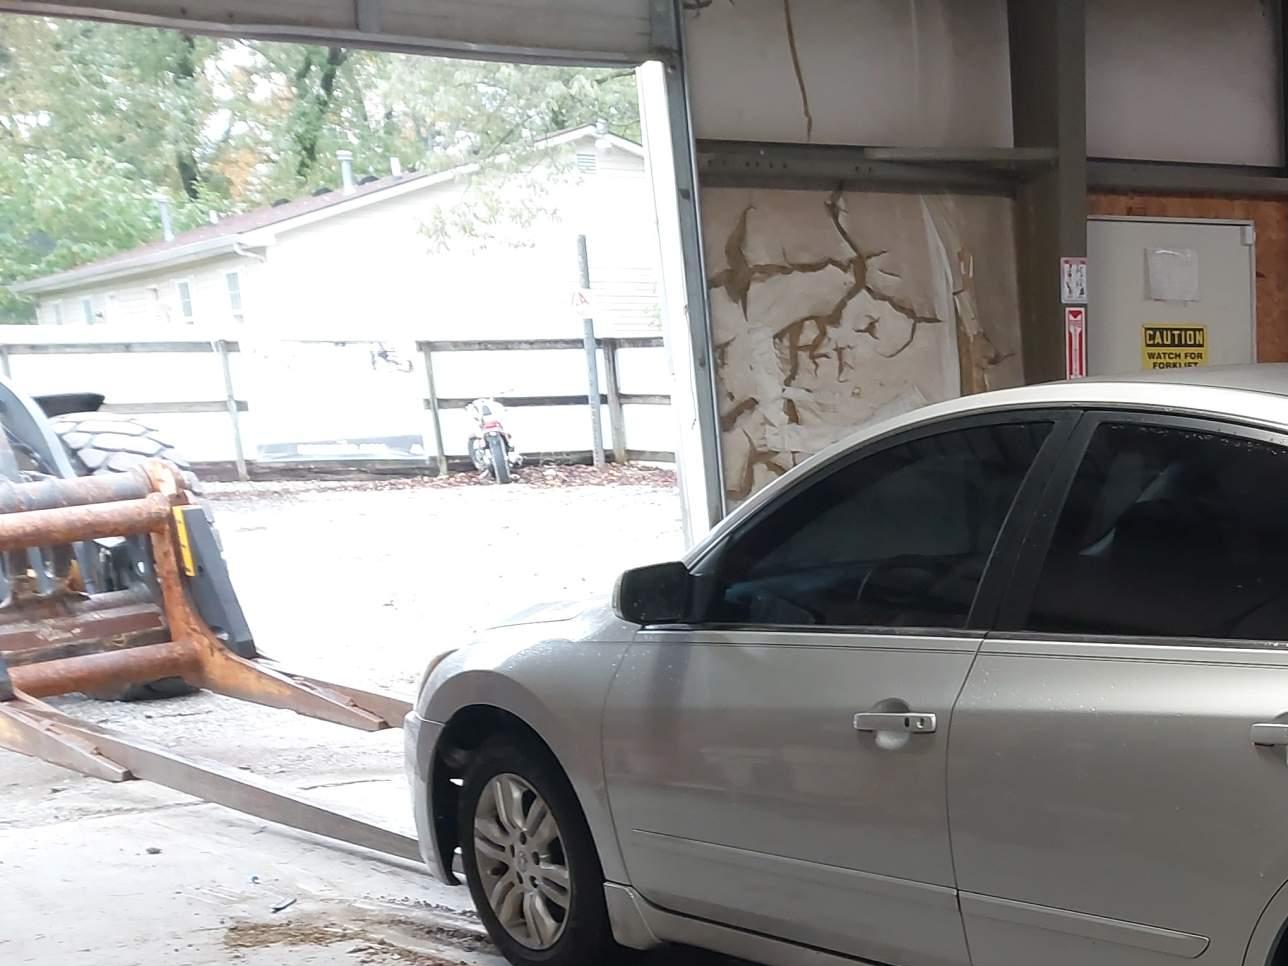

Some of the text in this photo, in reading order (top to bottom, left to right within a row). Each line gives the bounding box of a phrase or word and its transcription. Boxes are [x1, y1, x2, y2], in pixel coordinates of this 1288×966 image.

[1145, 329, 1204, 345] CAUTION
[1147, 352, 1203, 360] WATCH FOR
